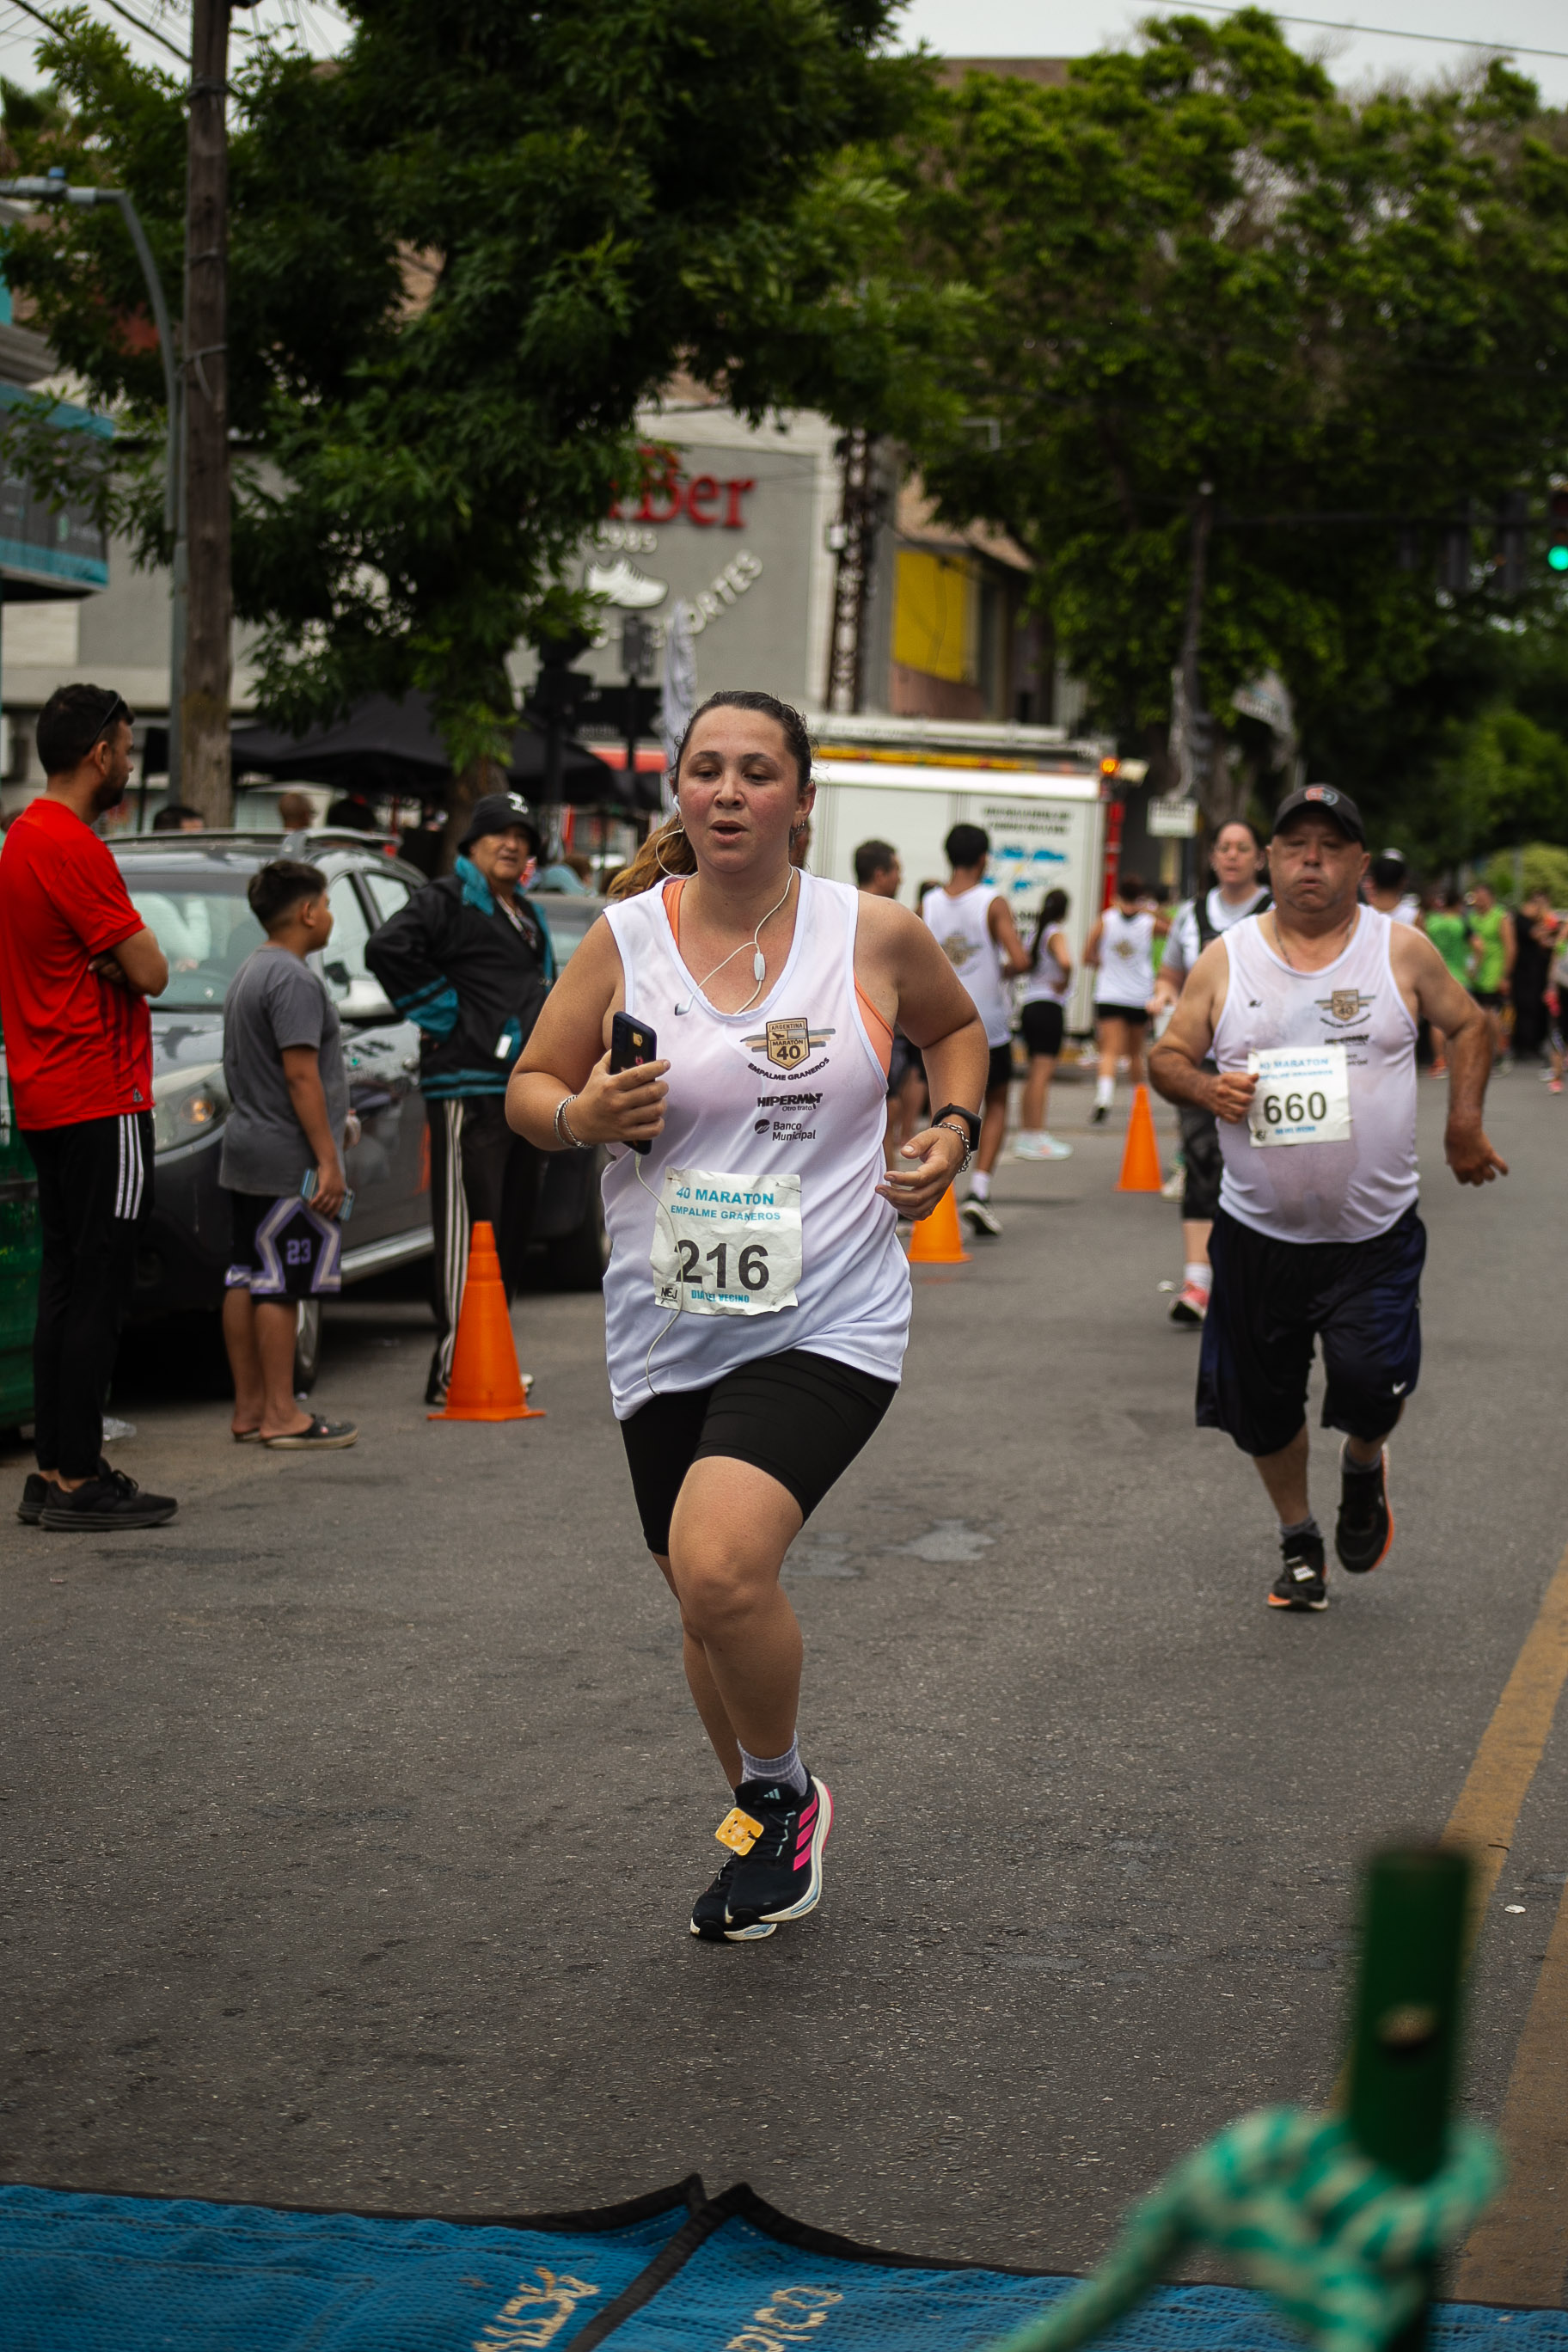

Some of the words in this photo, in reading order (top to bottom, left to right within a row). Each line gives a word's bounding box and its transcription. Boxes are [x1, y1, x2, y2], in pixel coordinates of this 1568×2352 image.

[776, 1045, 801, 1060] 40
[748, 1063, 786, 1081] EMPALME
[787, 1057, 830, 1081] GRANEROS
[1263, 1092, 1326, 1125] 660
[774, 1121, 802, 1130] Banco
[772, 1130, 816, 1141] Municipal
[677, 1187, 690, 1199] 40
[695, 1188, 774, 1205] MARATON
[671, 1205, 717, 1218] EMPALME
[720, 1210, 781, 1221] GRANEROS
[287, 1239, 311, 1265] 23
[674, 1240, 769, 1291] 216
[718, 1294, 750, 1303] VECINO
